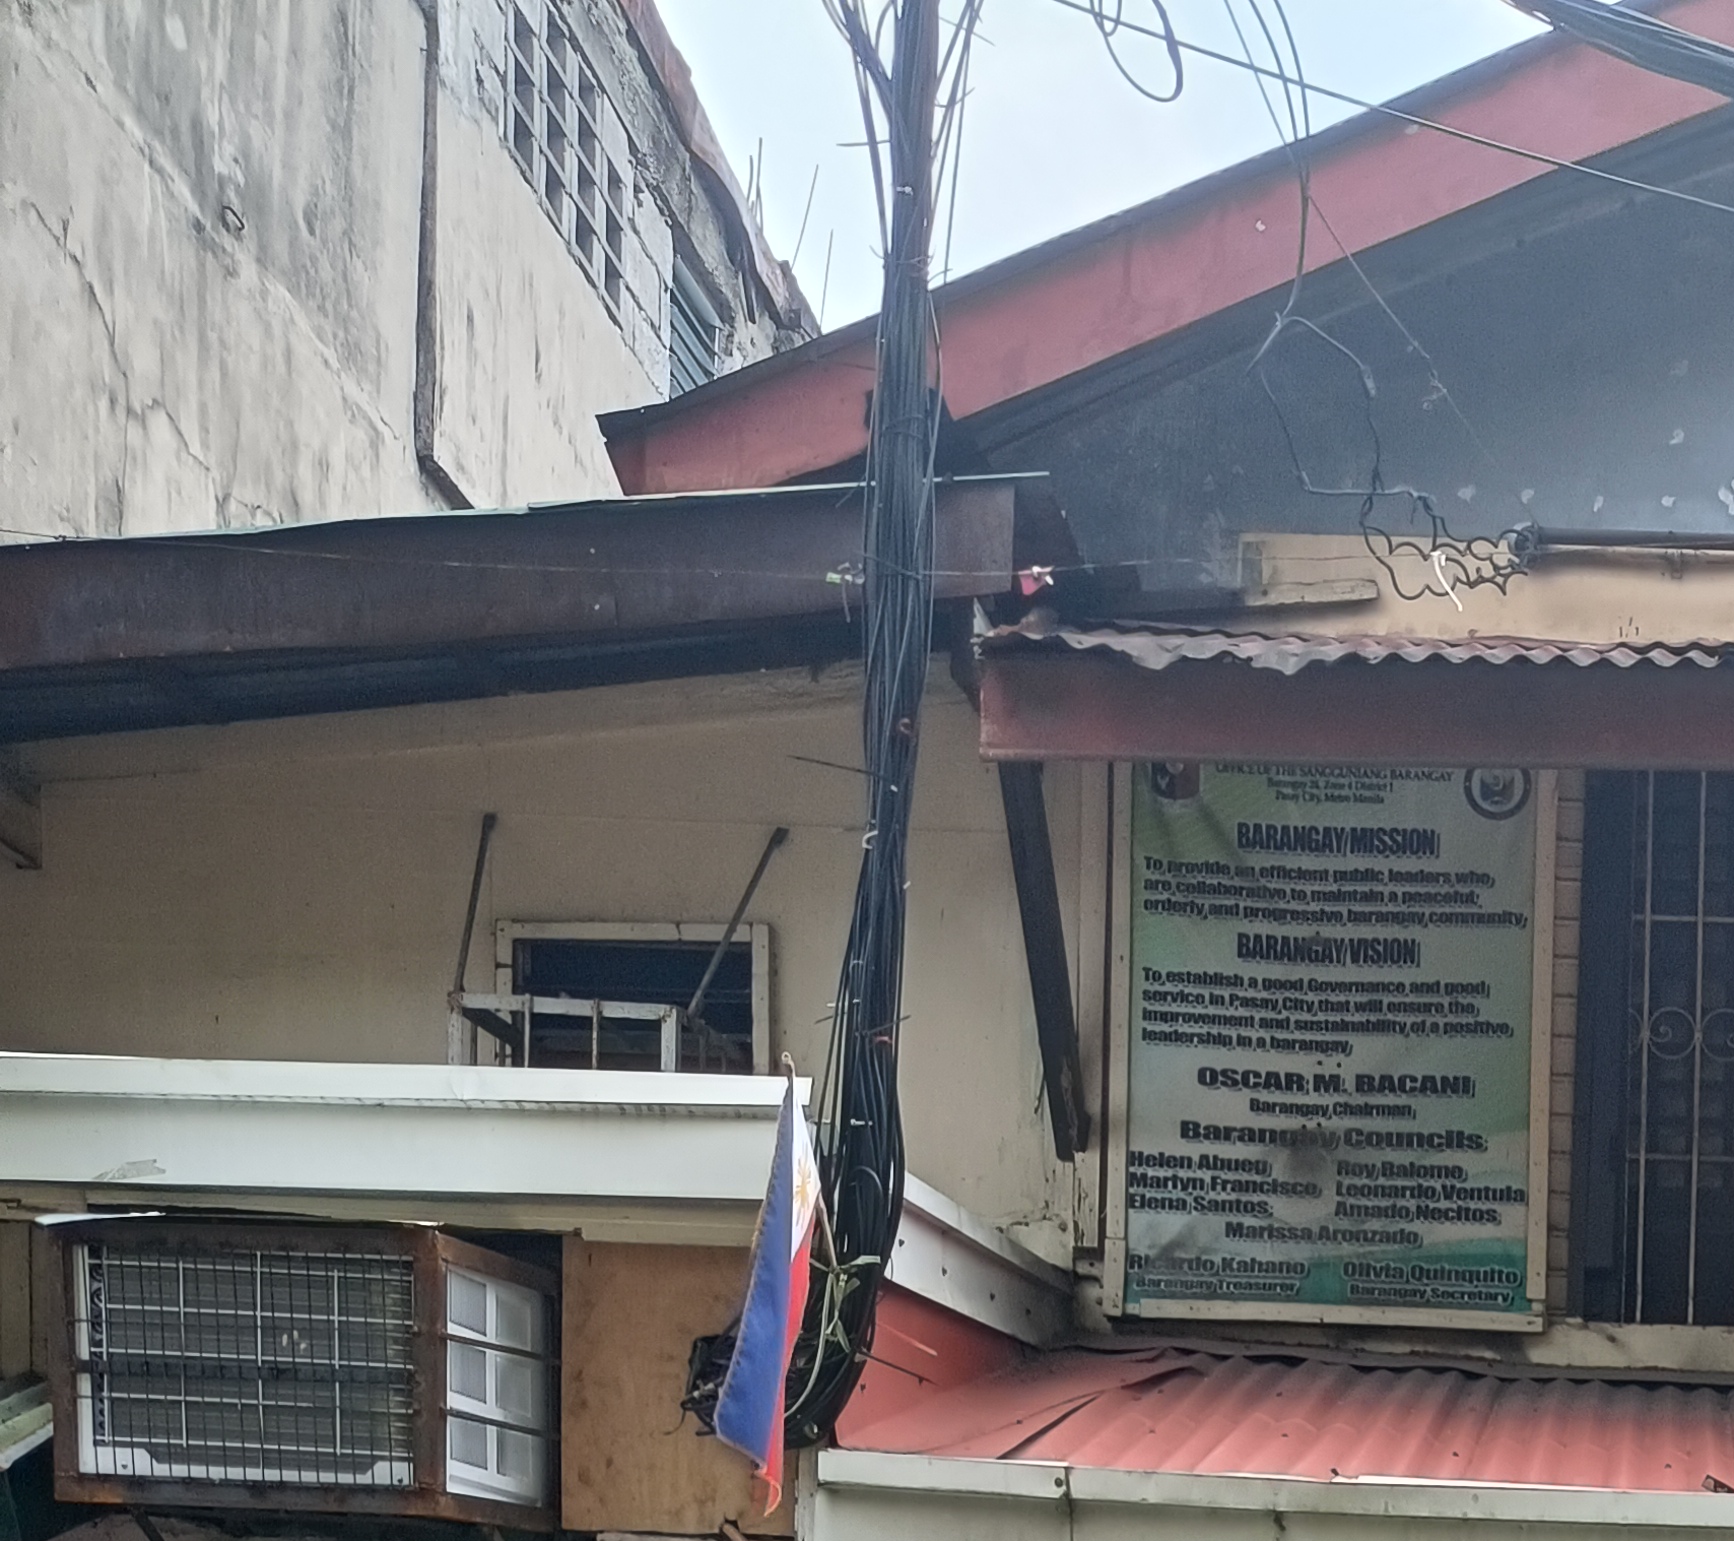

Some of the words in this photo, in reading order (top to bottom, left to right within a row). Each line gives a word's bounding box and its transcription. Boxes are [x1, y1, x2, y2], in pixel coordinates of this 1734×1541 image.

[1237, 822, 1345, 854] BARANGAY
[1350, 827, 1439, 857] MISSION
[1237, 932, 1345, 965] BARANGAY
[1350, 937, 1420, 967] VISION
[1198, 1067, 1306, 1093] OSCAR
[1313, 1073, 1347, 1093] M.
[1356, 1074, 1472, 1095] BACANI
[1250, 1098, 1331, 1117] Barangay
[1333, 1102, 1413, 1117] Chairman
[1180, 1120, 1340, 1148] Barangay
[1343, 1127, 1485, 1149] Councils
[1129, 1151, 1193, 1169] Helen
[1211, 1176, 1319, 1196] Francisco
[1335, 1180, 1438, 1199] Leonardo
[1128, 1193, 1188, 1211] Elena
[1193, 1196, 1269, 1214] Santos
[1225, 1221, 1313, 1240] Marissa
[1350, 1284, 1426, 1299] Barangay
[1430, 1287, 1510, 1303] Secretary
